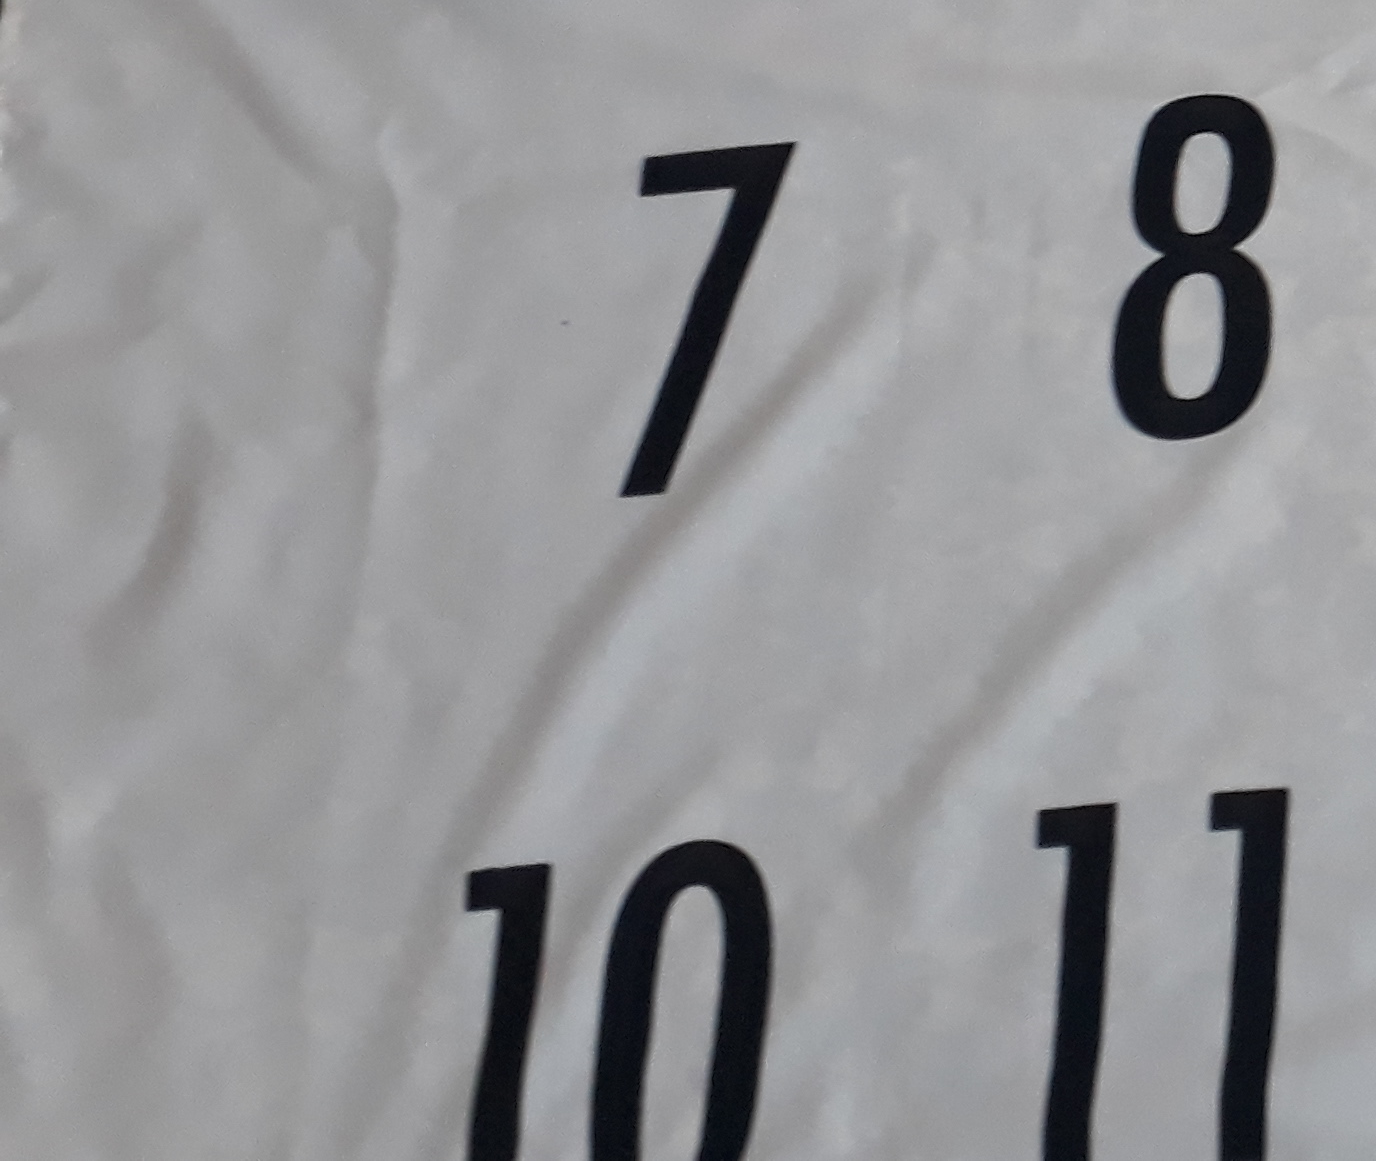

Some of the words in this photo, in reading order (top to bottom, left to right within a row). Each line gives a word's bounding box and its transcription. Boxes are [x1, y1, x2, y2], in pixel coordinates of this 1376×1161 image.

[619, 141, 797, 498] 7
[1110, 93, 1276, 441] 8
[464, 839, 775, 1161] 10
[1036, 787, 1291, 1161] 11
